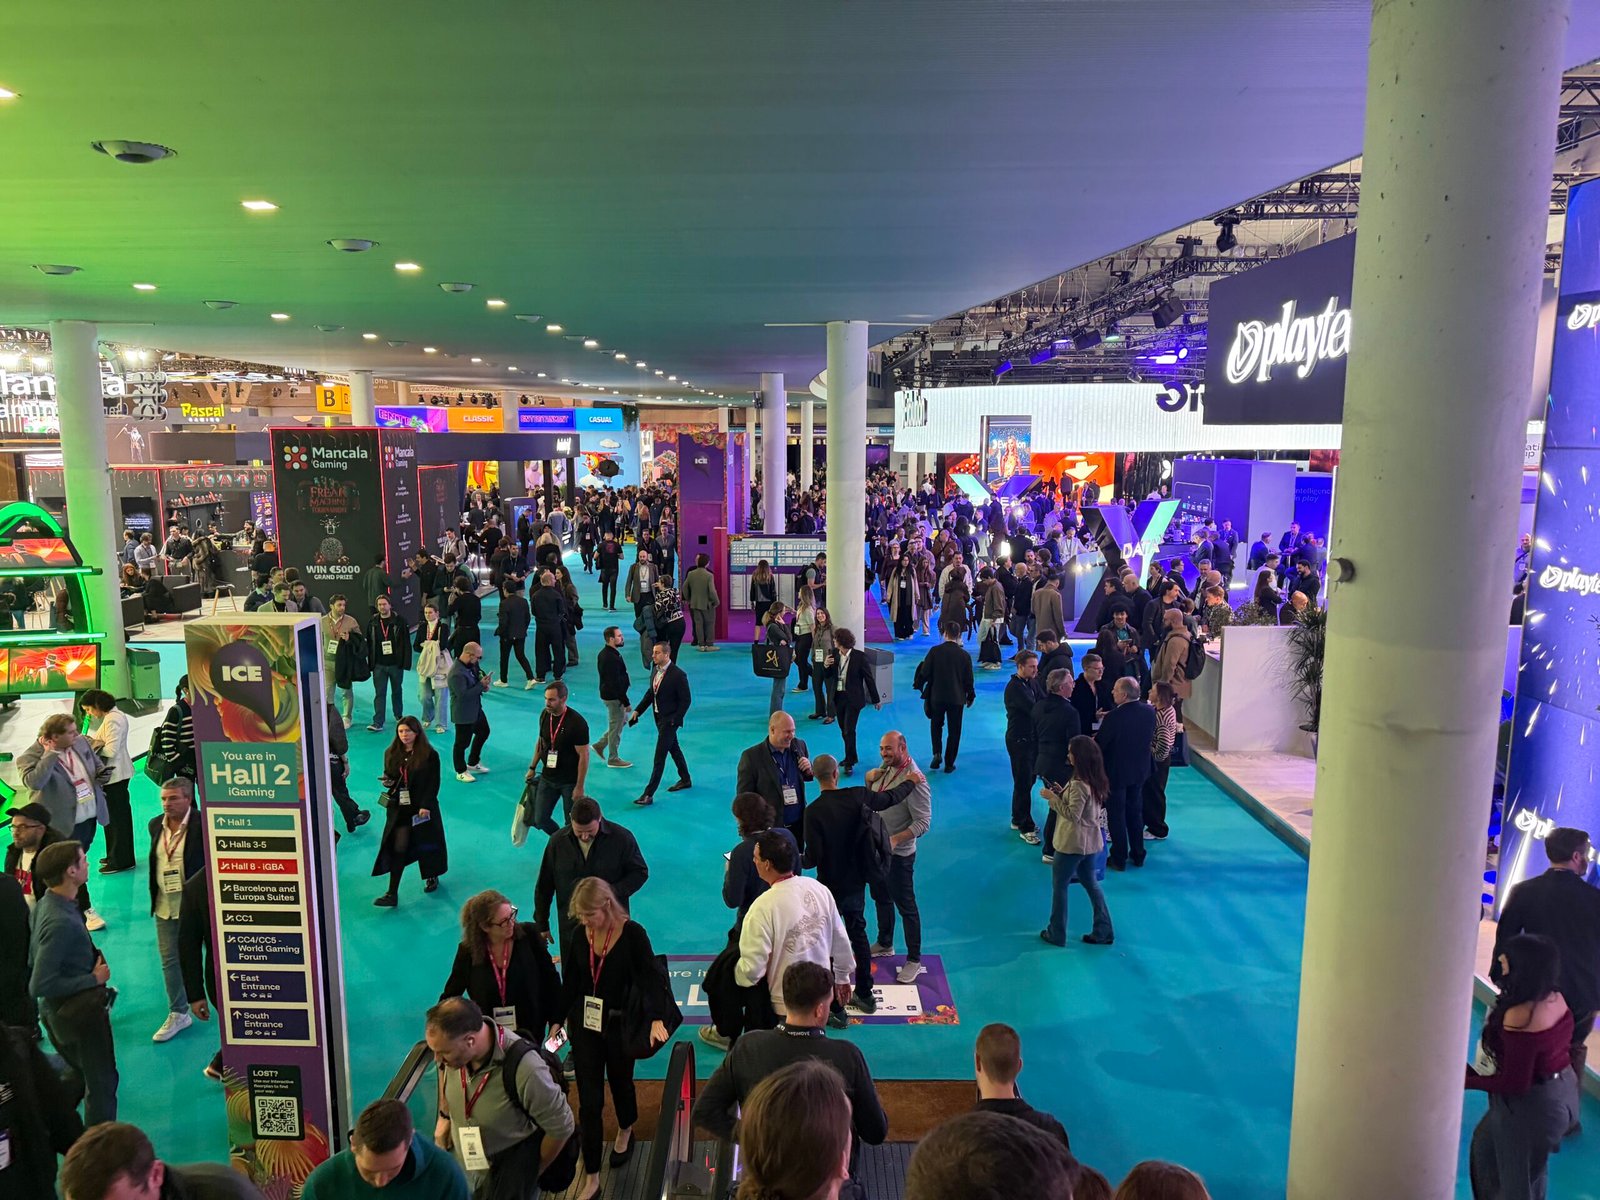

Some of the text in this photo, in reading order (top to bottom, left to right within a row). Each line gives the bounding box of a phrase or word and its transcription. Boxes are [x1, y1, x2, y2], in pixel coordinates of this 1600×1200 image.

[323, 389, 336, 407] B
[181, 403, 225, 417] Pascal
[463, 415, 494, 423] CLASSIC
[312, 446, 368, 459] Mancala
[394, 445, 415, 458] Mancala
[312, 459, 348, 471] Gaming
[184, 474, 268, 488] DEATH
[1121, 540, 1161, 559] DATA
[306, 565, 361, 574] WIN €5000
[221, 665, 263, 682] ICE
[221, 751, 277, 761] You are in
[210, 763, 291, 785] Hall 2
[228, 787, 276, 799] iGaming
[228, 818, 253, 827] Hall 1
[229, 840, 267, 849] Halls 3-5
[231, 862, 248, 871] Hall
[249, 862, 256, 871] 8
[262, 863, 285, 871] iGBA
[233, 884, 296, 894] Barcelona and
[234, 892, 295, 903] Europa Suites
[235, 914, 254, 923] CC1
[237, 935, 277, 944] CC4/CC5
[238, 944, 300, 955] World Gaming
[239, 952, 268, 961] Forum
[240, 974, 260, 982] East
[241, 982, 281, 991] Entrance
[243, 1011, 269, 1020] South
[244, 1020, 284, 1029] Entrance
[252, 1069, 279, 1077] LOST?
[267, 1112, 287, 1120] ICE
